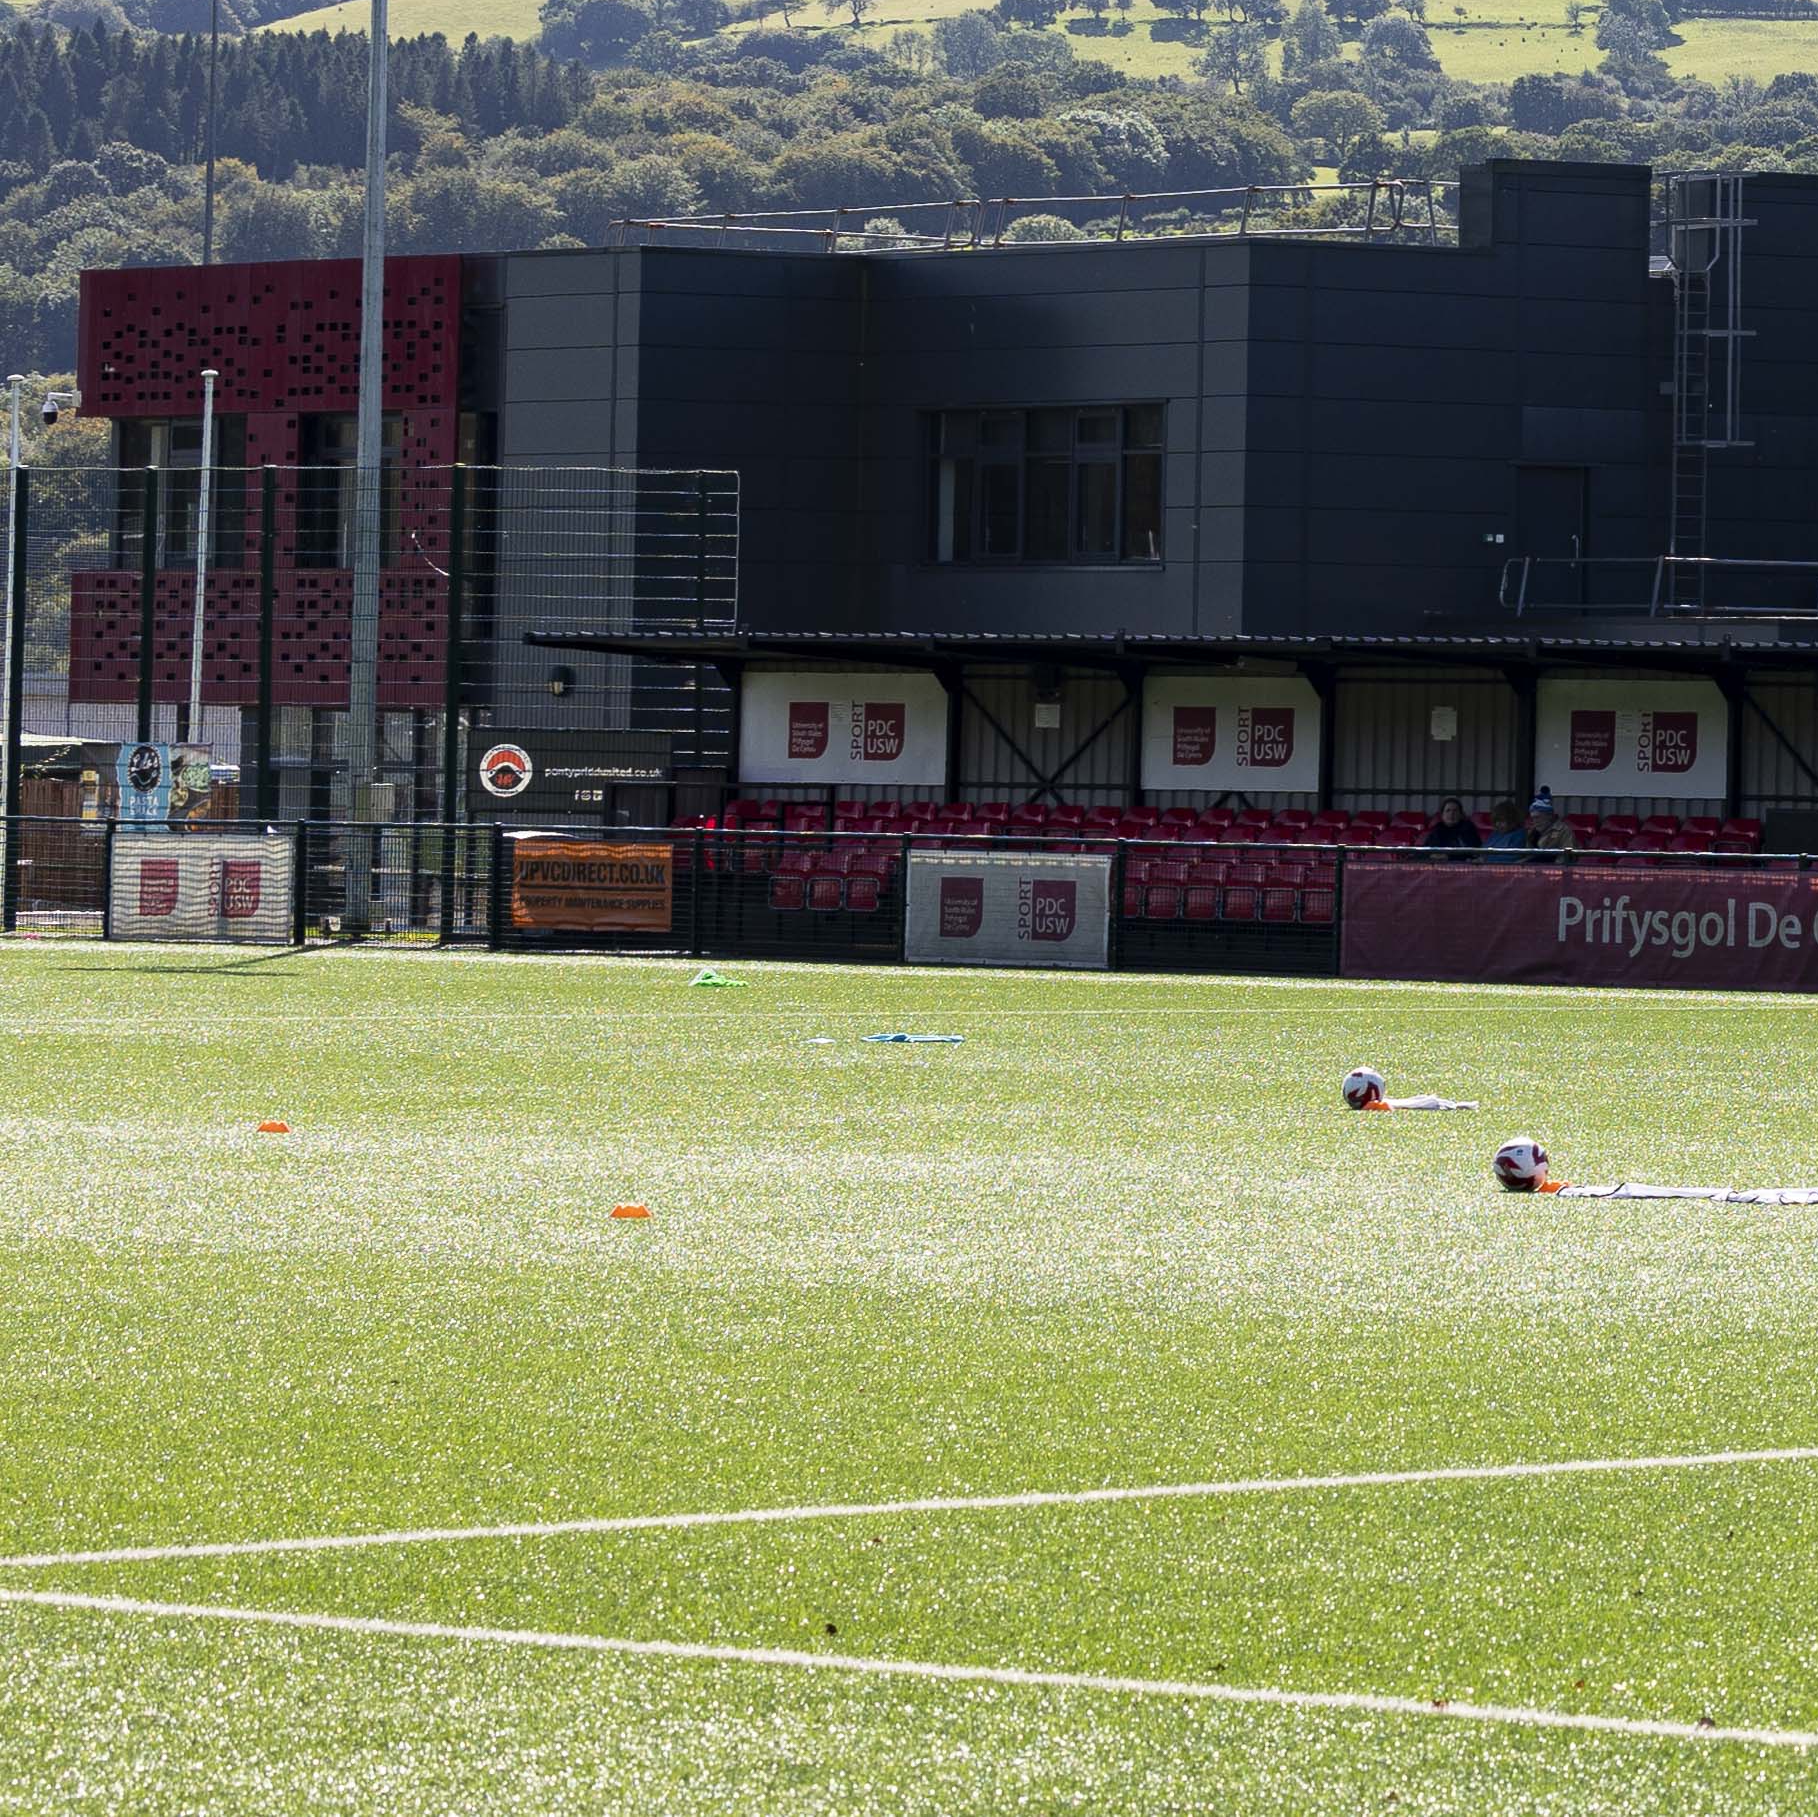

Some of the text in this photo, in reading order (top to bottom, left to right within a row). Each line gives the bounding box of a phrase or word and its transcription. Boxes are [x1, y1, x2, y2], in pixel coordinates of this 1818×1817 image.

[851, 700, 863, 760] SPORT
[867, 721, 895, 735] PDC
[1256, 726, 1284, 741] PDC
[1237, 706, 1249, 766] SPORT
[1656, 731, 1687, 746] PDC
[867, 739, 898, 753] USW
[1255, 744, 1287, 759] USW
[1656, 750, 1690, 765] USW
[130, 796, 159, 806] PASTA
[520, 860, 665, 884] UPVCDIRECT.CO.UK
[225, 878, 250, 893] PDC
[223, 896, 254, 910] USW
[1018, 878, 1031, 941] SPORT
[1036, 898, 1066, 914] PDC
[1036, 918, 1069, 933] USW
[1558, 896, 1736, 958] Prifysgol
[1748, 902, 1801, 948] De
